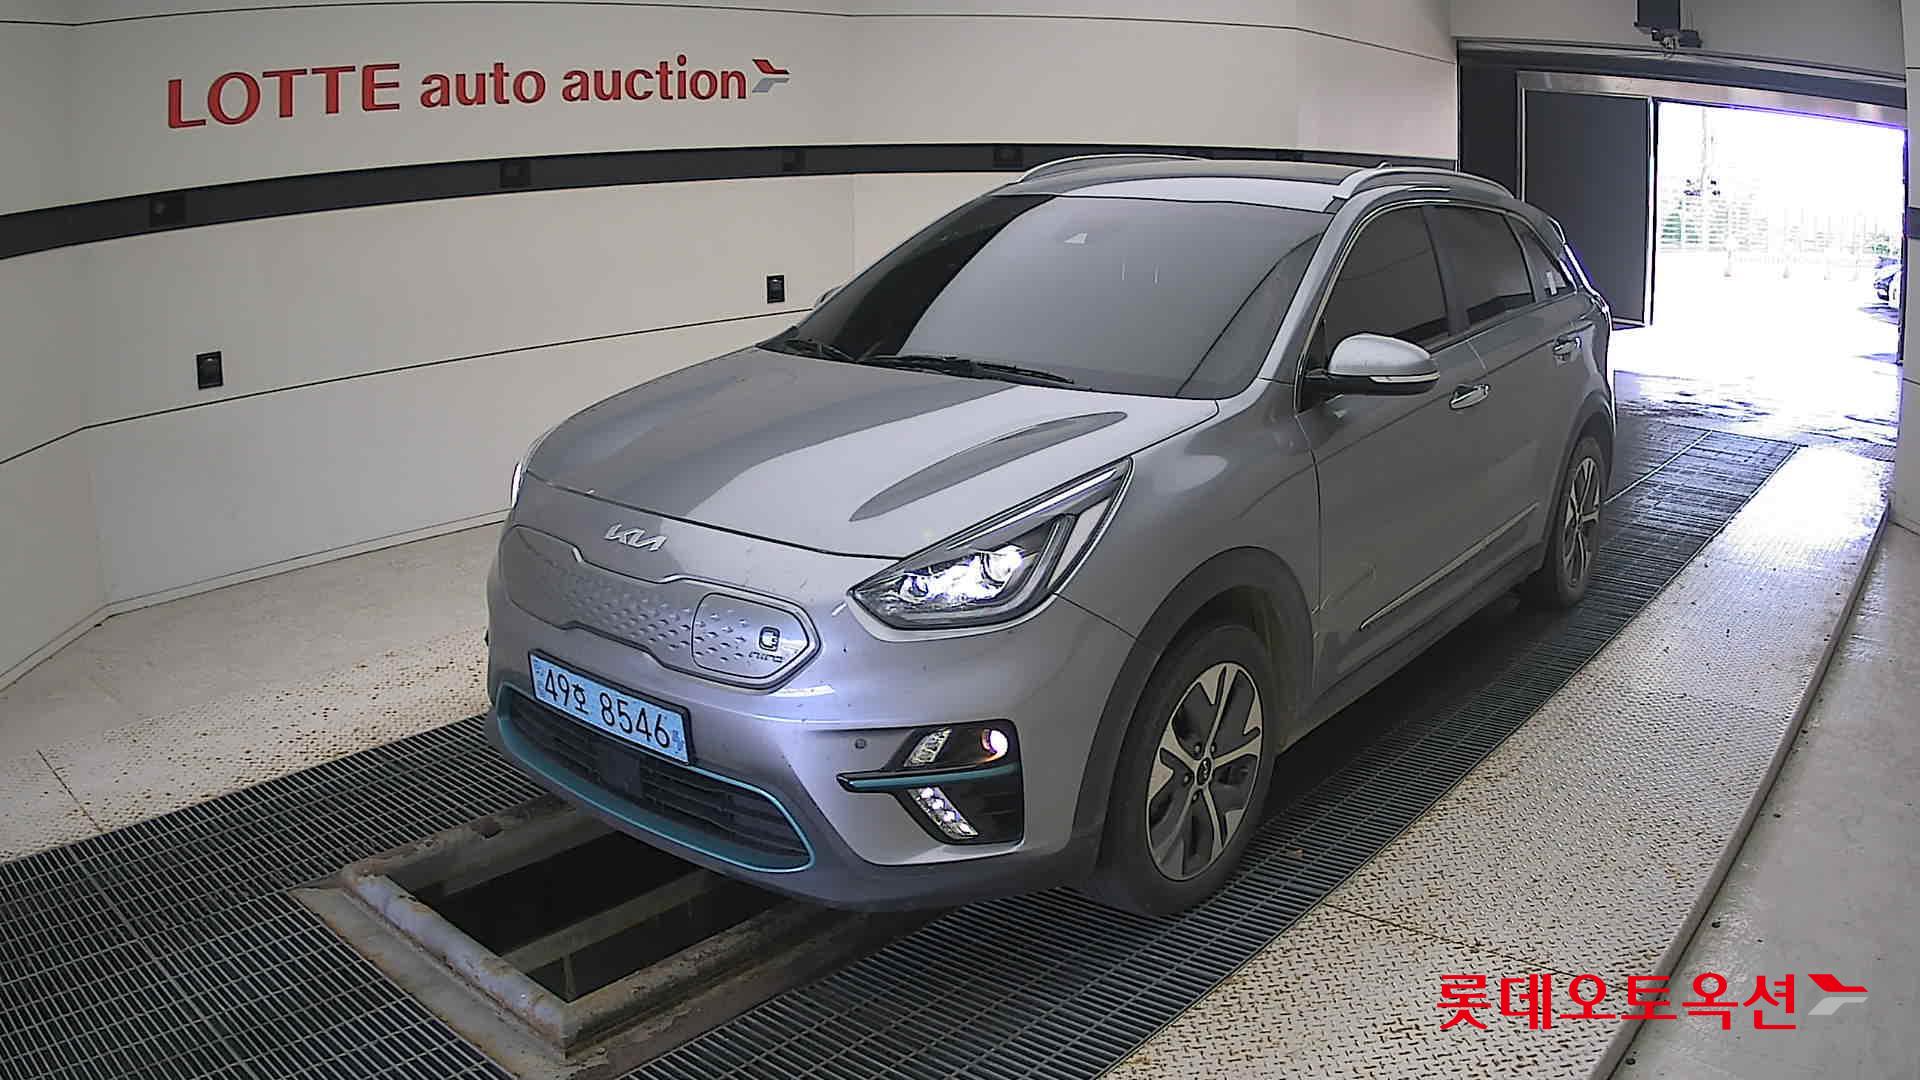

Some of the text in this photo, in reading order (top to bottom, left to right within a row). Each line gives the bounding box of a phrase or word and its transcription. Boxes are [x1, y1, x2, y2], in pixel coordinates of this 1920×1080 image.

[168, 54, 747, 129] LOTTE auto auction
[599, 692, 670, 748] 8546
